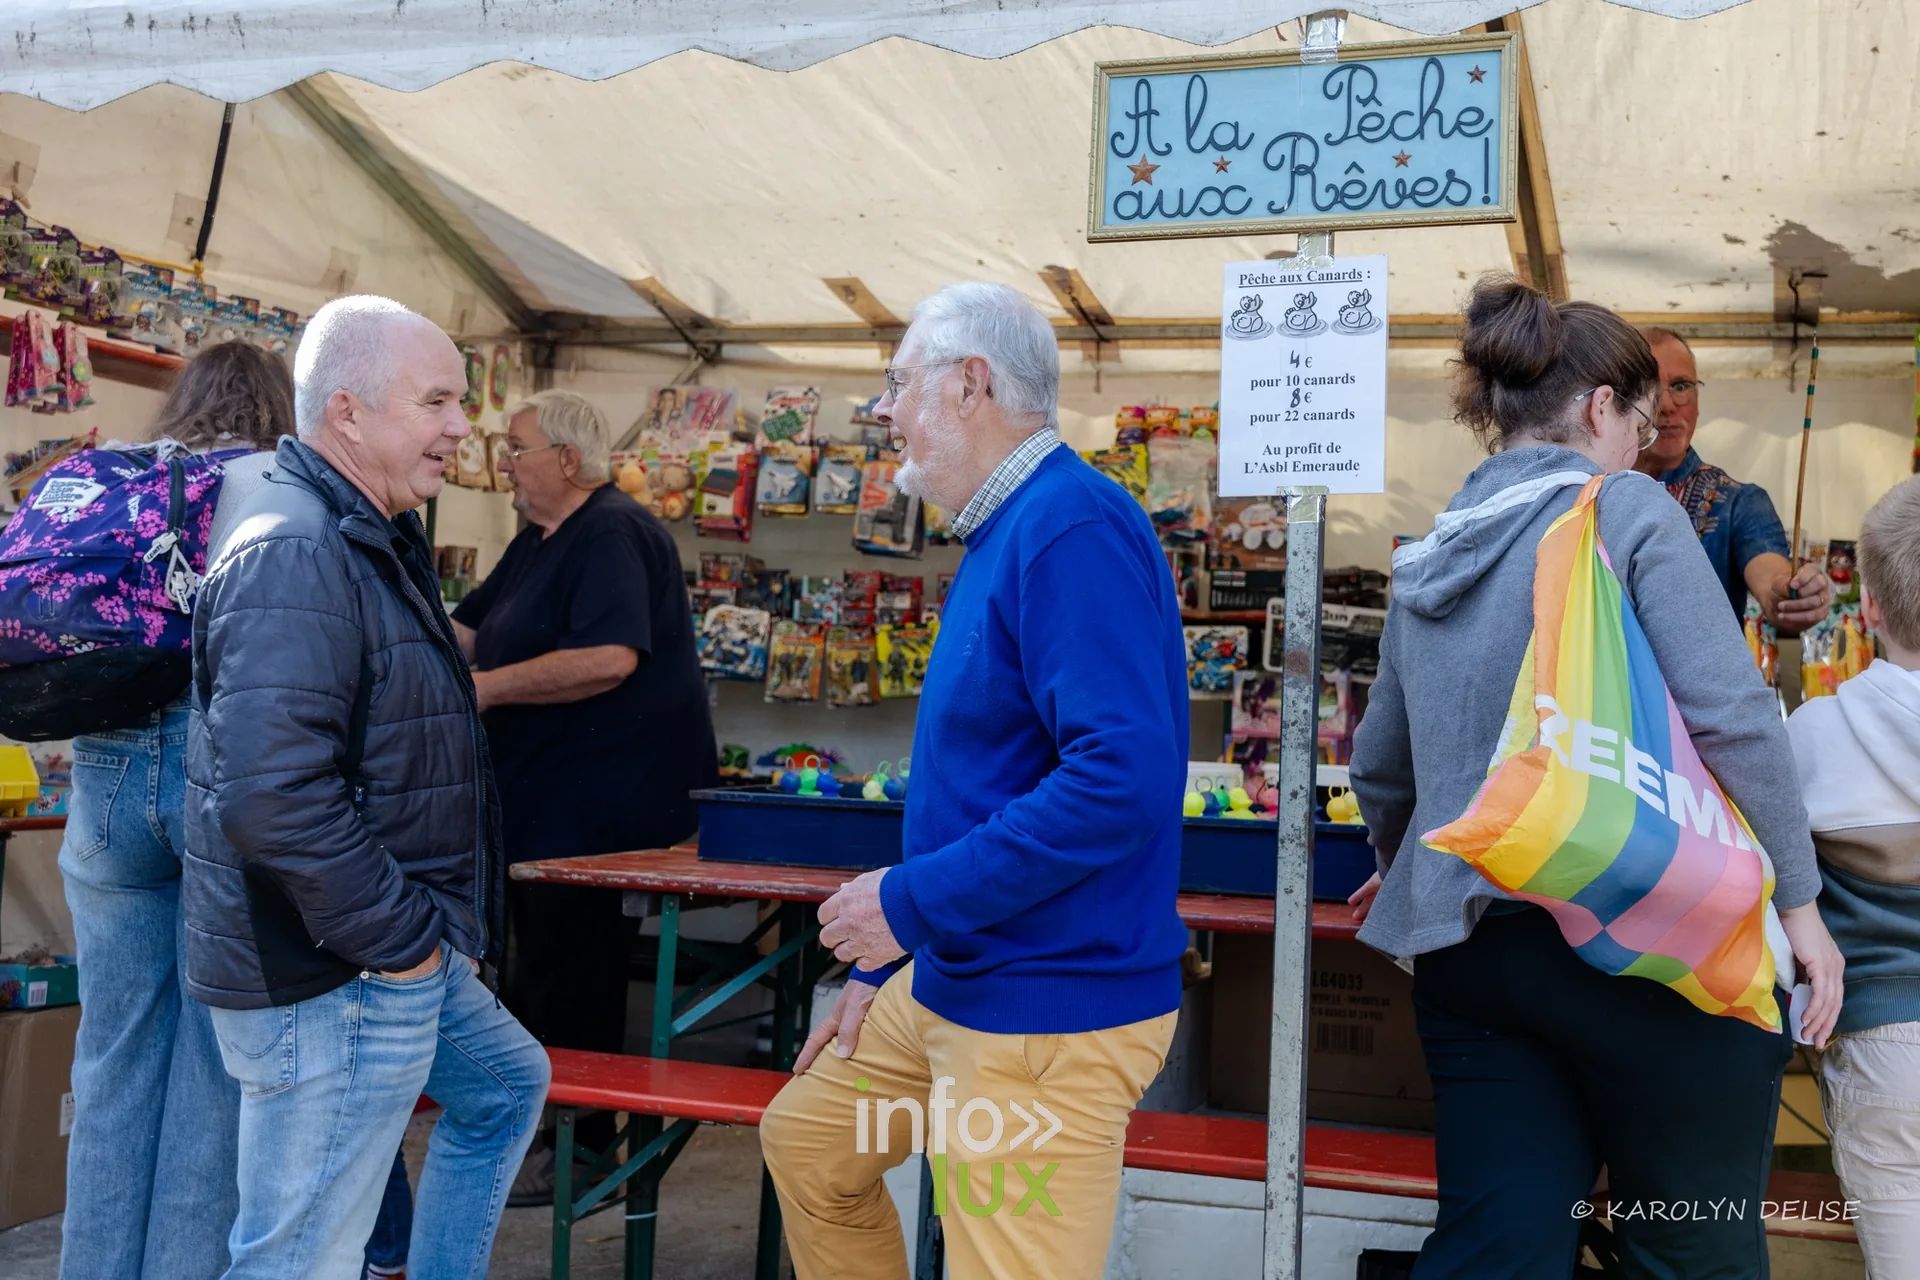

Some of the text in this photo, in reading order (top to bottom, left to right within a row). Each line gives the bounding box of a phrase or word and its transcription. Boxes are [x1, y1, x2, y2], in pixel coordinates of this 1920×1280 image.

[1110, 56, 1494, 158] A la Pêche
[1113, 131, 1492, 220] aux Rêves!
[1239, 273, 1276, 286] Pêche
[1279, 273, 1302, 283] aux
[1307, 269, 1363, 282] Canards
[1290, 349, 1313, 368] 4 €
[1250, 373, 1356, 391] pour 10 canards
[1290, 388, 1313, 408] 8 €
[1250, 409, 1356, 426] pour 22 canards
[1262, 442, 1342, 457] Au profit de
[1244, 460, 1361, 474] L’Asbl Emeraude
